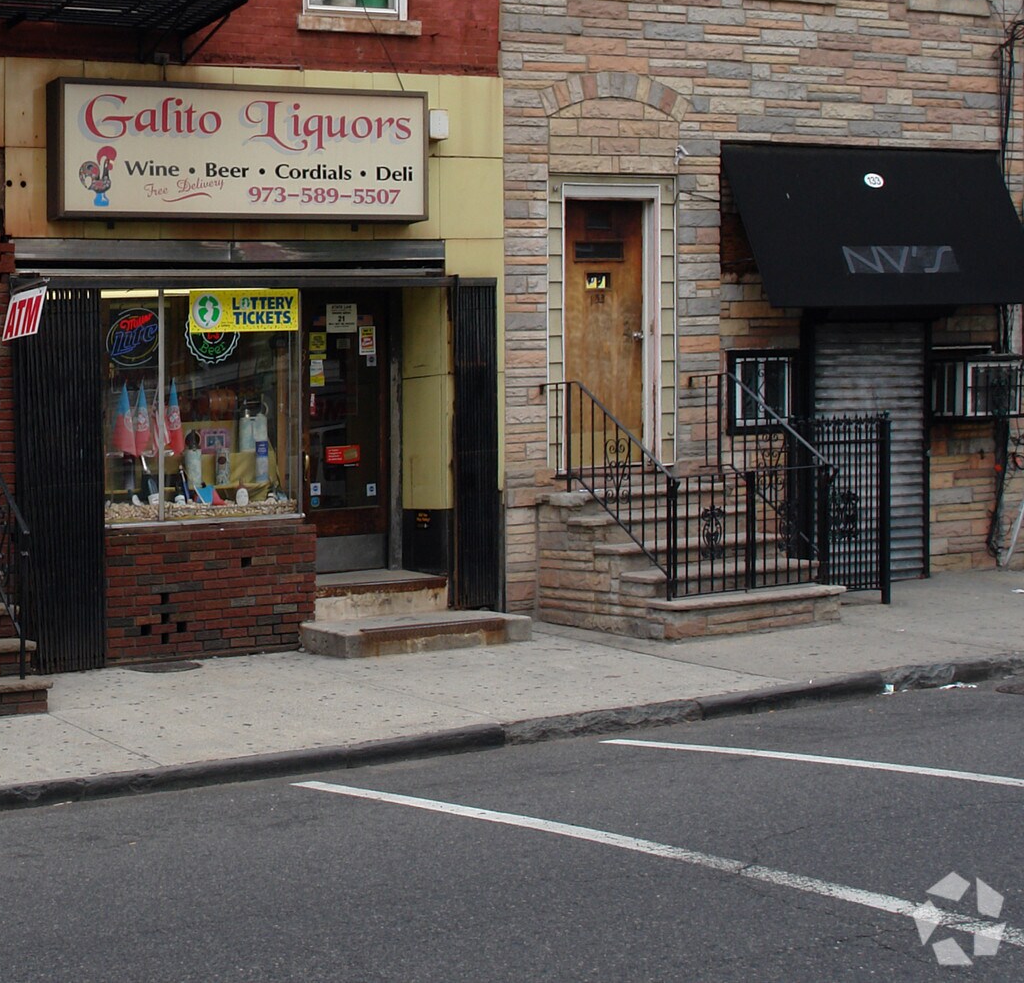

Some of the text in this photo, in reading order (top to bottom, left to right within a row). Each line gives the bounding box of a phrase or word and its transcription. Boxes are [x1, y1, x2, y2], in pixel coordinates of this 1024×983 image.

[83, 93, 412, 152] Galito Liquors
[124, 160, 413, 182] Wine Beer Cordials Deli
[867, 176, 882, 186] 133
[144, 177, 225, 198] Free Delivery
[248, 186, 402, 206] 973-589-5507
[232, 296, 294, 310] LOTTERY
[4, 295, 43, 340] ATM
[233, 310, 291, 325] TICKETS
[199, 340, 226, 356] Beer
